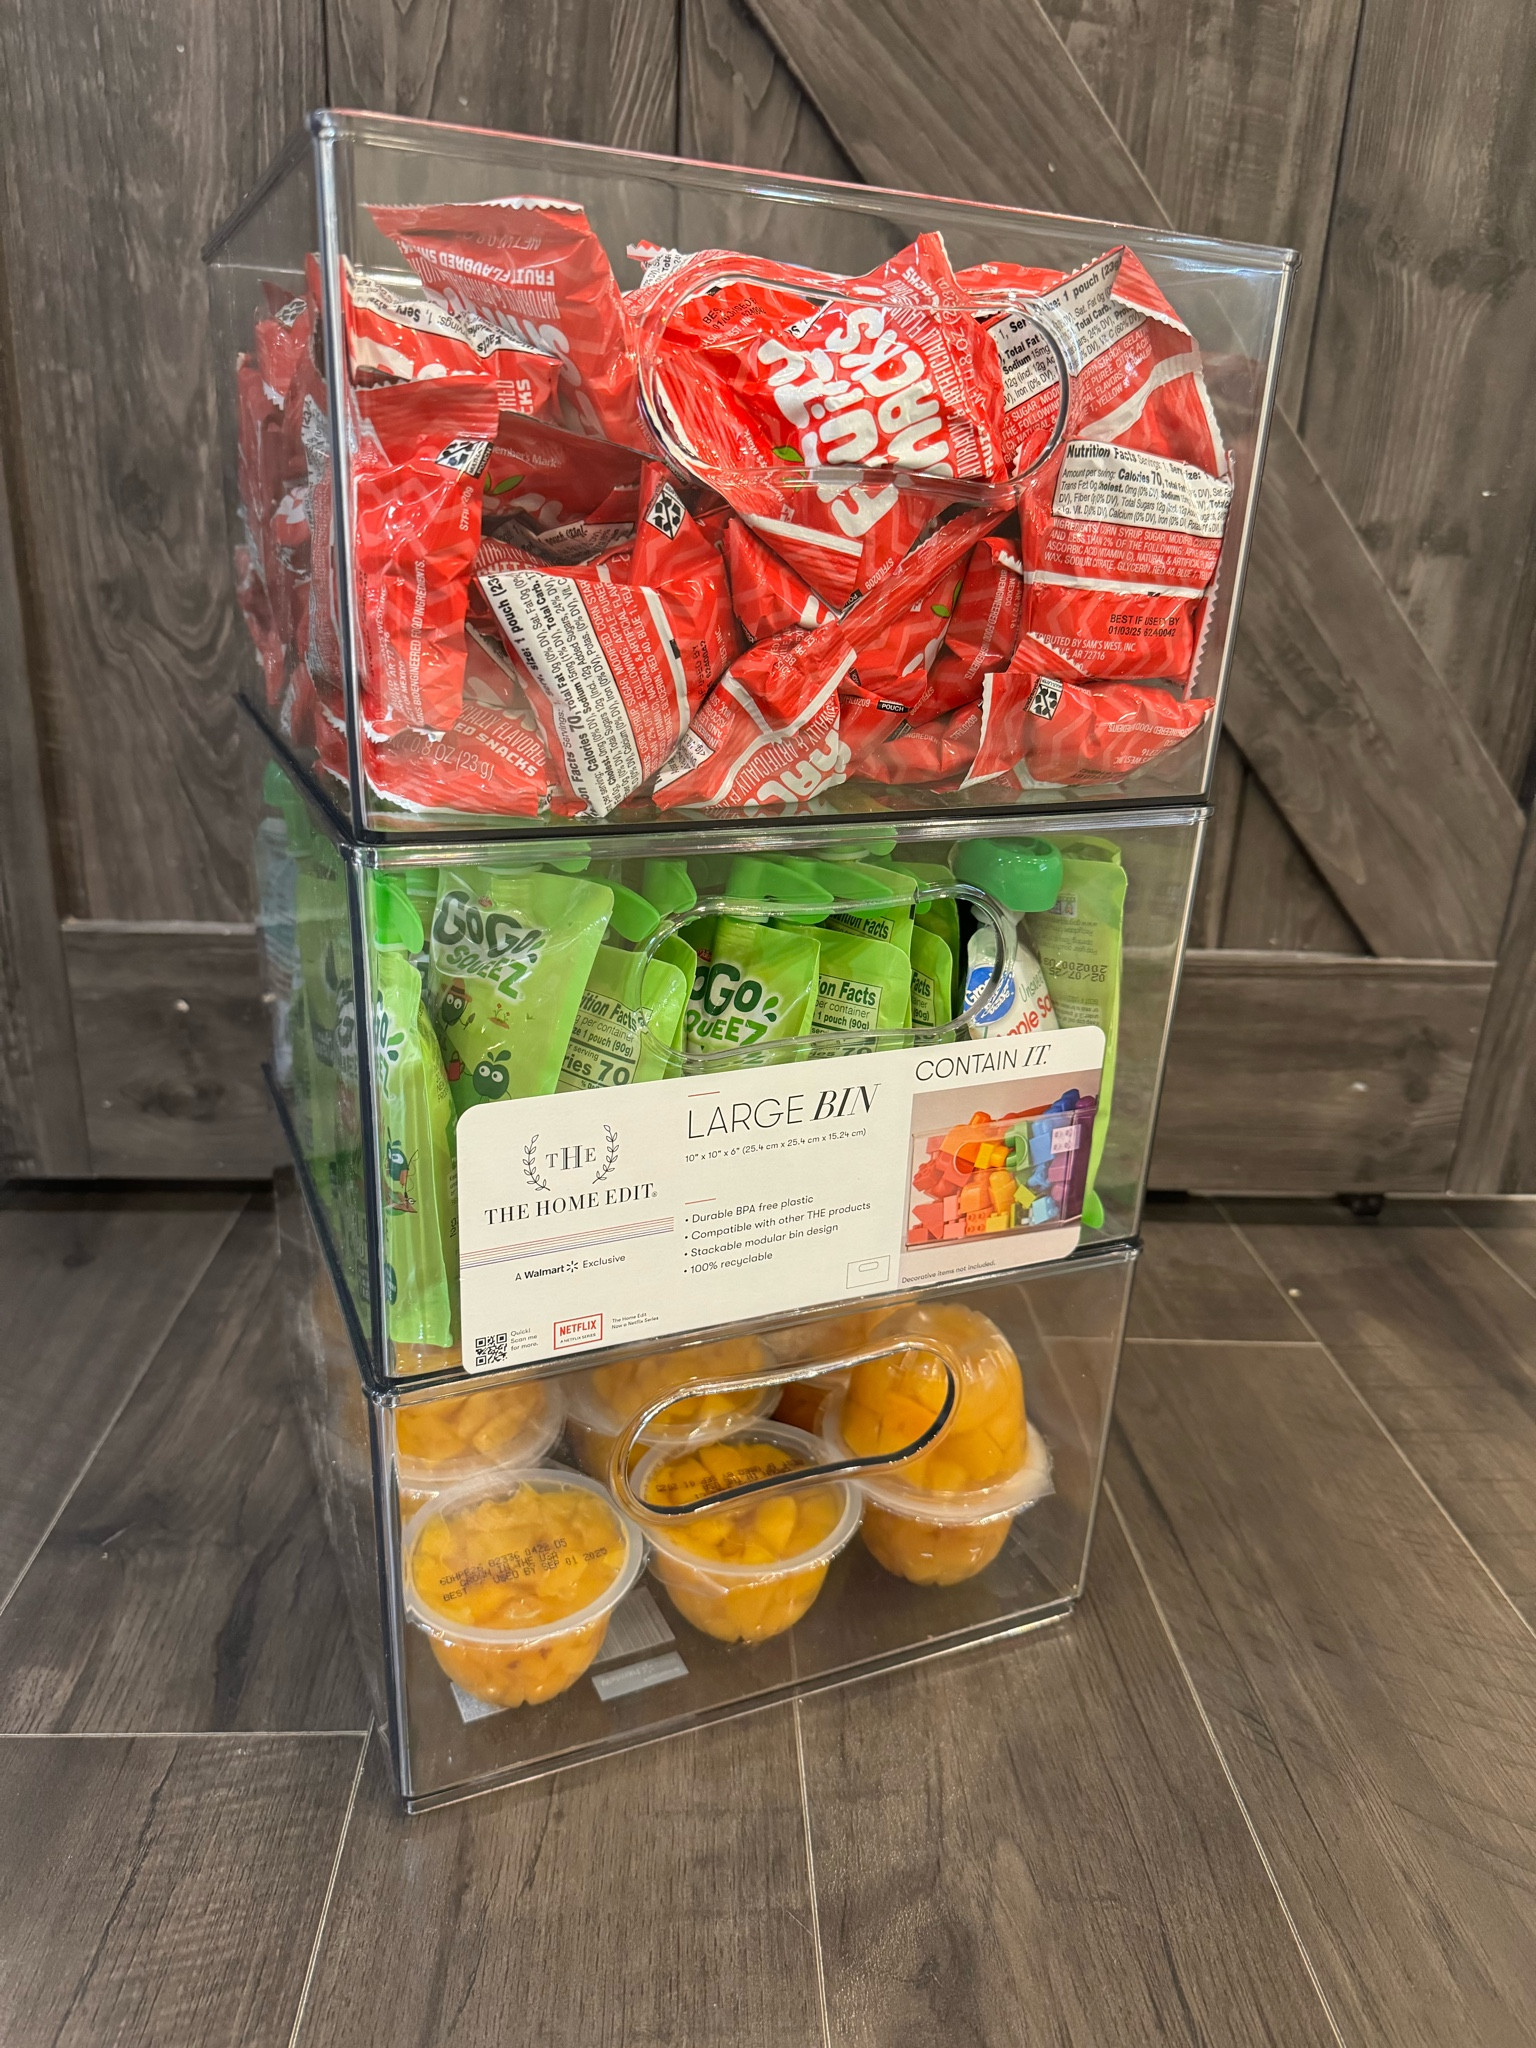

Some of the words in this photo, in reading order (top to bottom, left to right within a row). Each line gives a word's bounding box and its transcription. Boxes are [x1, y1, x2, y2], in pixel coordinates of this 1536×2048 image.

[510, 264, 556, 289] FRUIT
[1068, 271, 1102, 298] pouch
[1003, 341, 1027, 360] Total
[1024, 333, 1040, 348] Fat
[1000, 353, 1032, 376] Sodium
[1065, 437, 1111, 464] Nutrition
[1117, 468, 1150, 484] Calories
[527, 579, 547, 606] Carb.
[592, 582, 613, 615] PUREE
[498, 598, 523, 635] pouch
[520, 599, 535, 614] Fat
[536, 603, 557, 631] Total
[588, 604, 608, 632] CORN
[1110, 613, 1132, 624] BEST
[1134, 615, 1142, 624] IF
[1168, 616, 1179, 627] BY
[603, 614, 625, 645] APPLE
[614, 608, 642, 655] ARTIFICIAL
[1107, 624, 1141, 636] 01/03/25
[567, 641, 587, 668] Added
[599, 632, 625, 676] MODIFIED
[644, 653, 661, 673] RED
[1071, 649, 1083, 659] AR
[1084, 650, 1105, 661] 72716
[551, 671, 568, 690] Fat
[616, 643, 647, 699] FOLLOWING:
[636, 661, 660, 699] NATURAL
[571, 680, 593, 715] Sodium
[880, 702, 906, 713] POUCH
[476, 734, 539, 778] SNACKS
[573, 731, 600, 773] Calories
[562, 749, 585, 785] Facts
[838, 981, 877, 1006] Facts
[607, 1002, 640, 1030] Facts
[822, 1012, 847, 1027] pouch
[827, 1001, 871, 1018] container
[580, 1016, 595, 1029] per
[594, 1021, 635, 1043] container
[573, 1045, 599, 1061] serving
[587, 1031, 611, 1047] pouch
[610, 1038, 634, 1057] (90g)
[1022, 1044, 1052, 1069] IT.
[595, 1059, 632, 1087] 70
[915, 1045, 1017, 1083] CONTAIN
[688, 1092, 804, 1139] LARGE
[809, 1081, 881, 1121] BIN
[742, 1142, 763, 1155] (25.4
[766, 1142, 778, 1150] cm
[787, 1136, 805, 1147] 25.4
[828, 1129, 849, 1141] 15.24
[851, 1127, 866, 1138] cm)
[545, 1141, 596, 1173] THE
[484, 1202, 529, 1225] THE
[535, 1190, 599, 1217] HOME
[691, 1220, 751, 1242] Compatible
[754, 1215, 776, 1229] with
[778, 1211, 804, 1225] other
[807, 1207, 825, 1220] THE
[828, 1200, 870, 1218] products
[692, 1207, 733, 1223] Durable
[736, 1203, 756, 1216] BPA
[758, 1199, 778, 1212] free
[780, 1193, 813, 1210] plastic
[690, 1238, 742, 1257] Stackable
[744, 1231, 786, 1248] modular
[788, 1228, 804, 1240] bin
[806, 1221, 838, 1237] design
[515, 1272, 521, 1281] A
[524, 1263, 565, 1279] Walmart
[582, 1251, 625, 1269] Exclusive
[690, 1260, 718, 1274] 100%
[720, 1250, 773, 1270] recyclable
[901, 1271, 935, 1284] Decorative
[937, 1267, 954, 1277] items
[956, 1265, 966, 1273] not
[510, 1336, 525, 1345] Scan
[559, 1318, 596, 1337] NETFLIX
[510, 1344, 520, 1353] for
